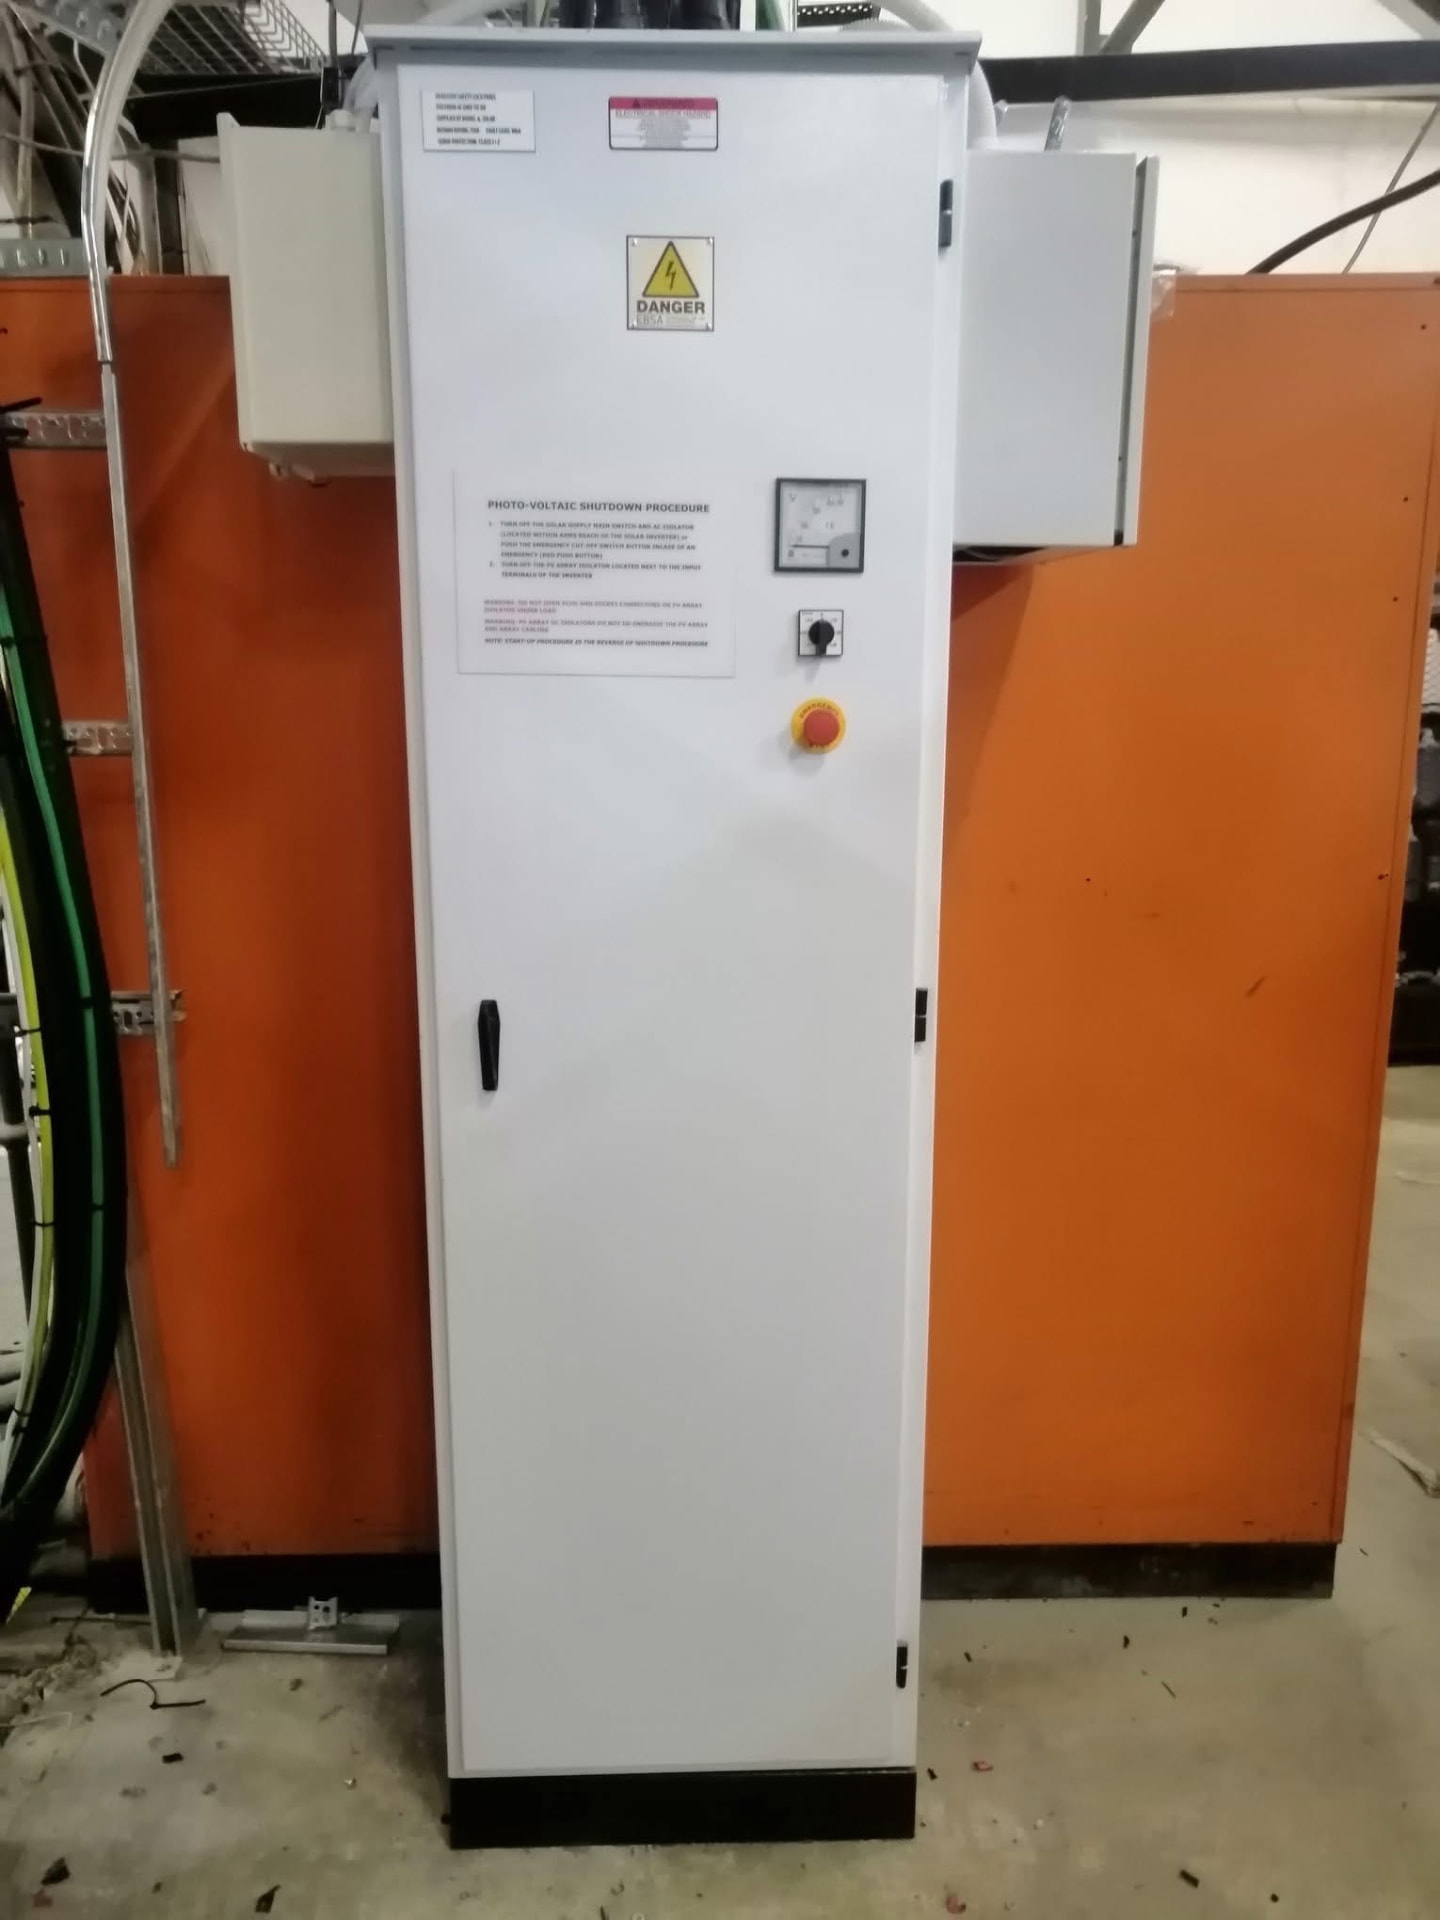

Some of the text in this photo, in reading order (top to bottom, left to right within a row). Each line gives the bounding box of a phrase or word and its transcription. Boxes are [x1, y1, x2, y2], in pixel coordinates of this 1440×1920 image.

[637, 300, 705, 314] DANGER
[488, 501, 710, 513] PHOTO-VOLTAIC SHUTDOWN PROCEDURE
